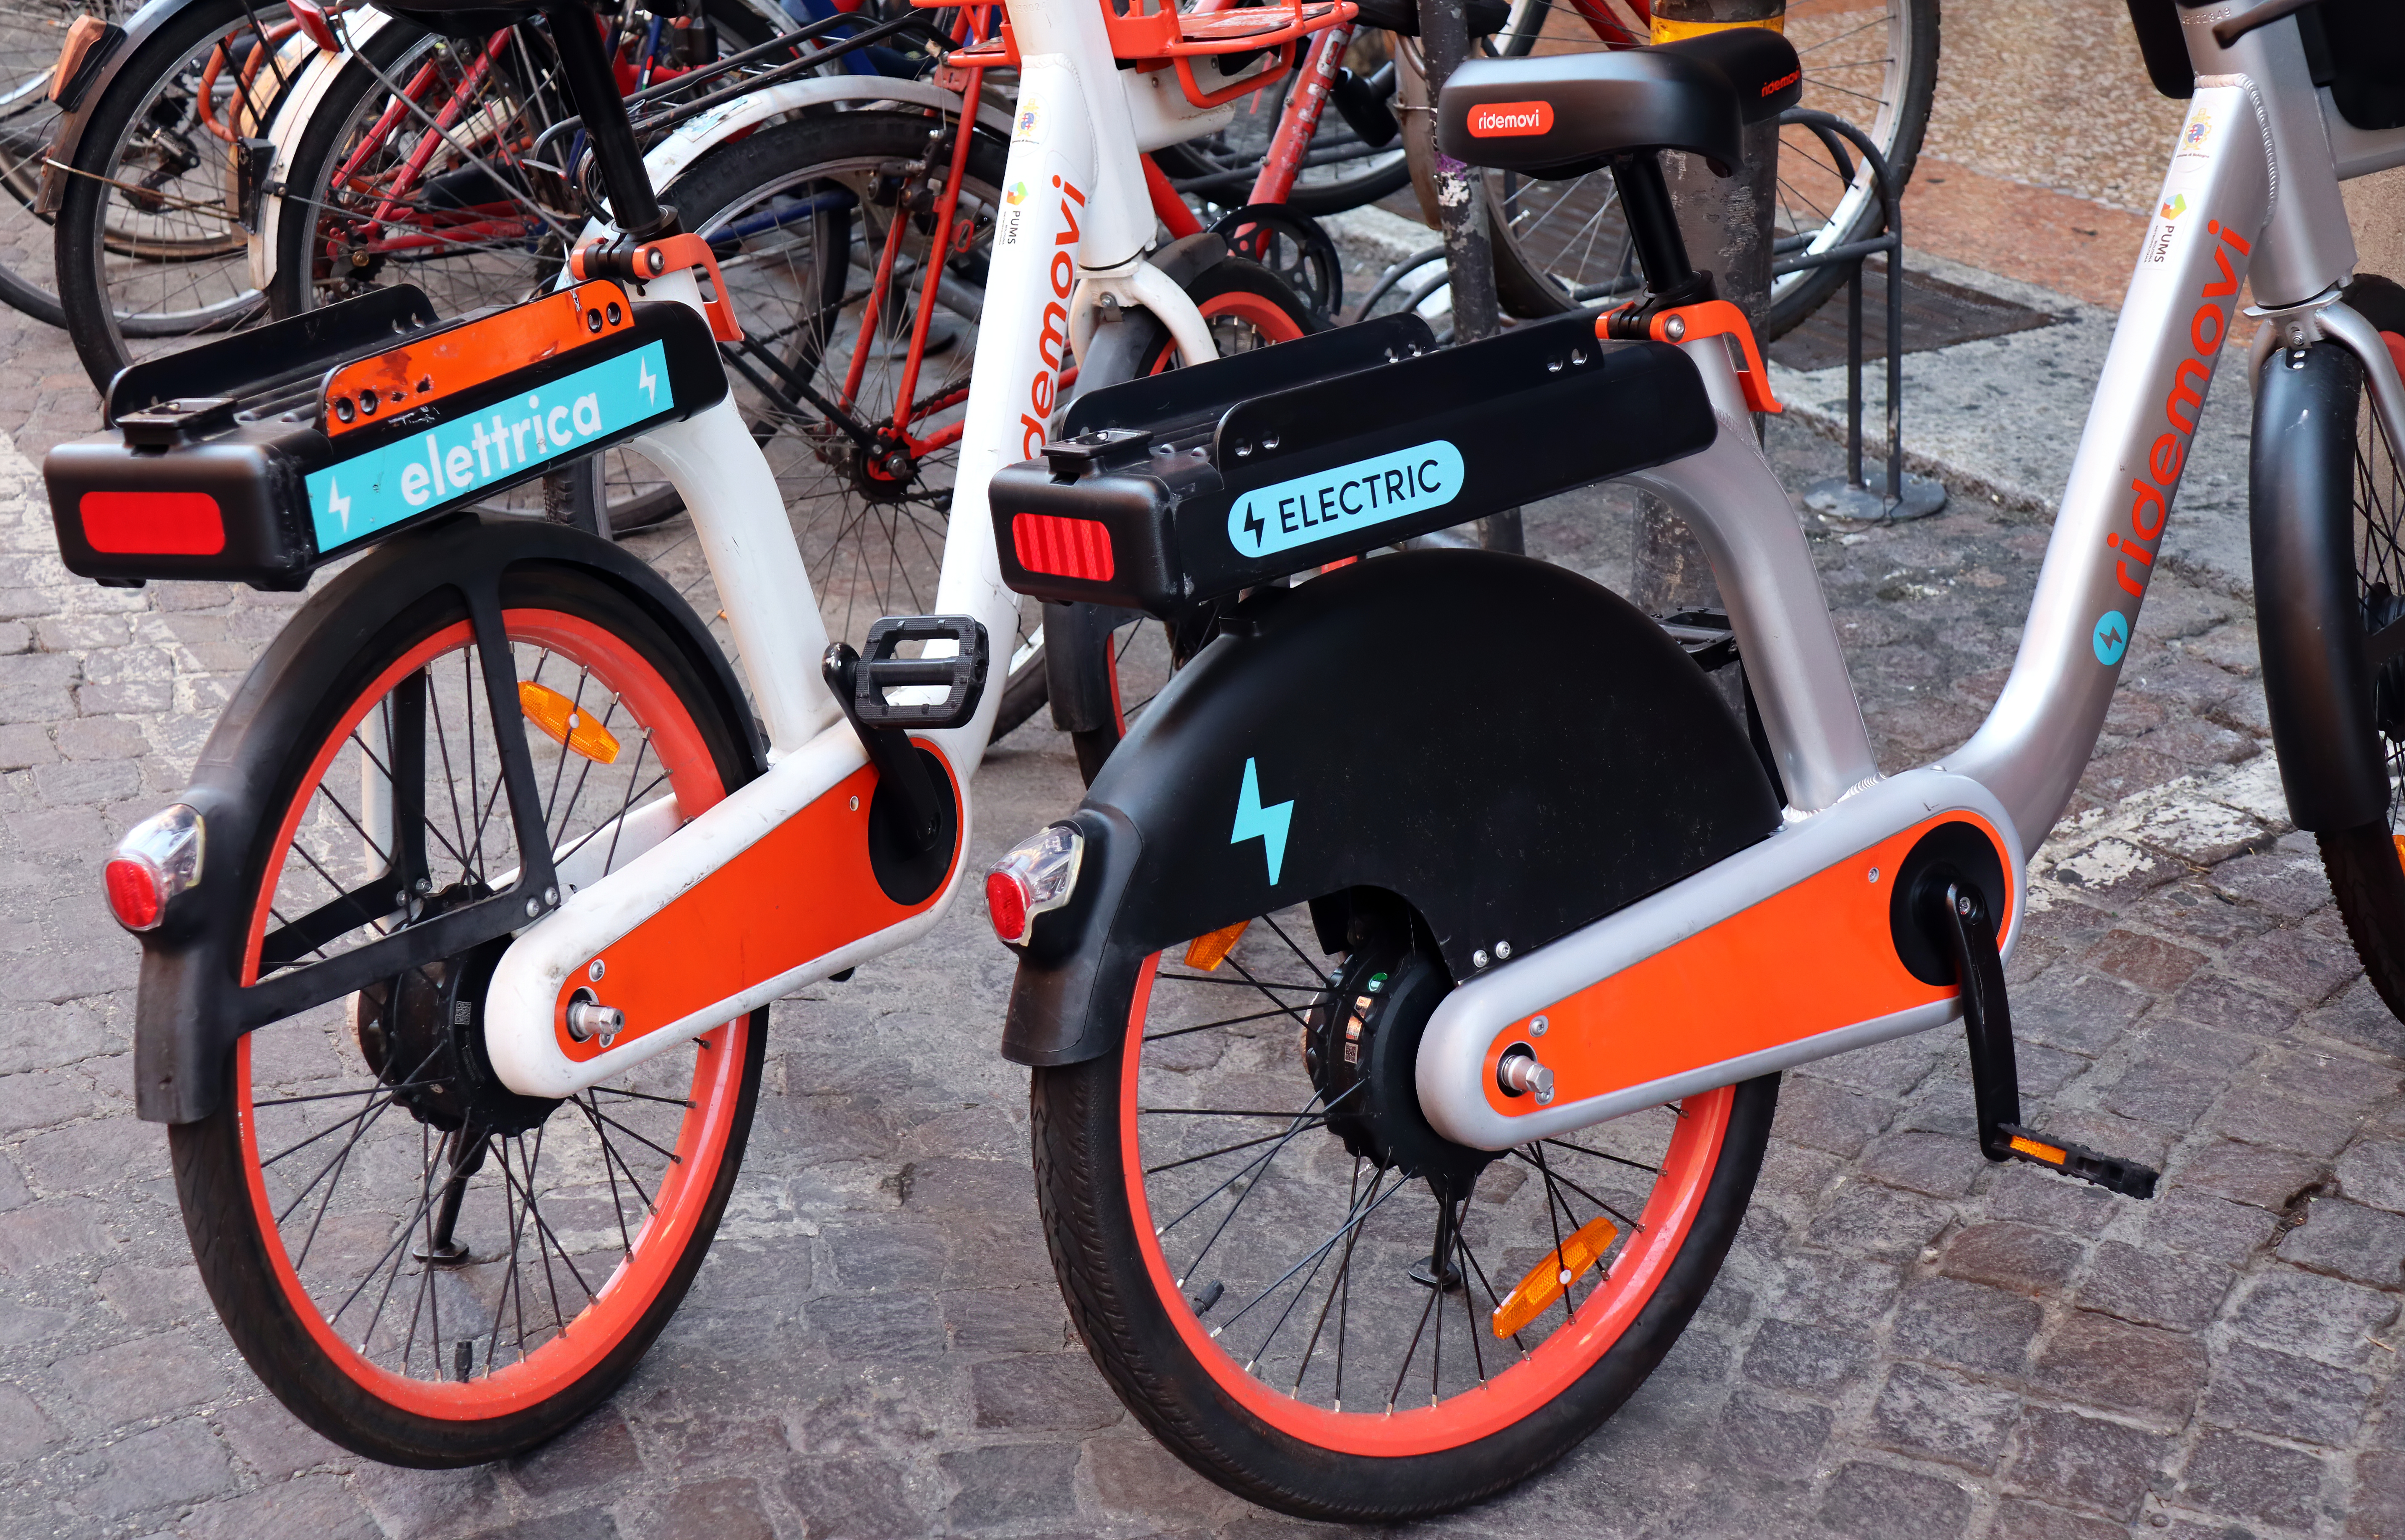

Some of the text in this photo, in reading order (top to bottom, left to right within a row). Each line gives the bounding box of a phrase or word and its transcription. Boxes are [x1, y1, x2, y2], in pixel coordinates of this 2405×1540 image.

[1762, 65, 1801, 98] ridemovi
[1479, 109, 1539, 130] ridemovi
[1008, 211, 1021, 244] PUMS
[2154, 226, 2174, 262] PUMS
[2148, 241, 2157, 262] BOLOGNA
[1009, 175, 1085, 465] demovi
[2107, 219, 2251, 597] ridemovi
[401, 392, 603, 506] elettrica
[1279, 459, 1441, 533] ELECTRIC
